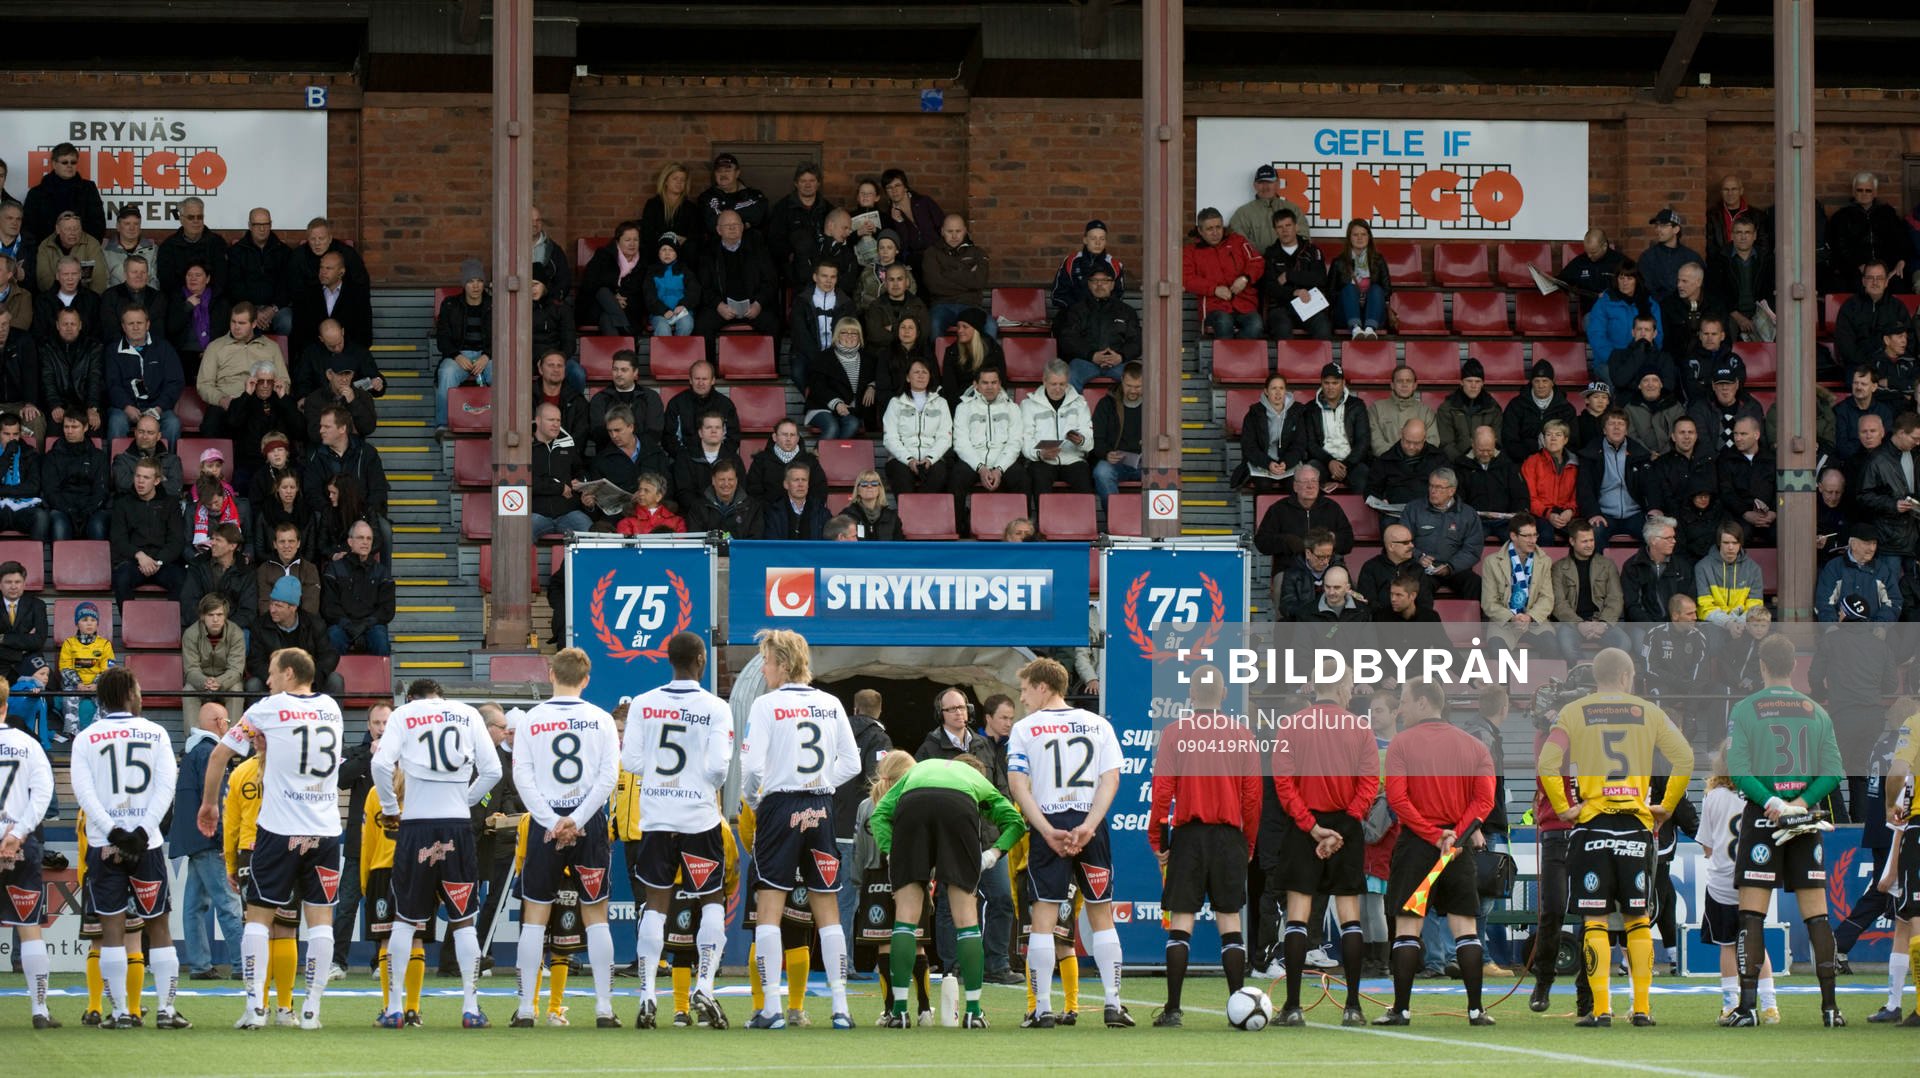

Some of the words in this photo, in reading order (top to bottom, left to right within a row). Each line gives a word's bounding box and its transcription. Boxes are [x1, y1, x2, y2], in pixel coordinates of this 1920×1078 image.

[308, 87, 325, 108] B
[69, 117, 187, 141] BRYNÄS
[1314, 128, 1424, 156] GEFLE
[1444, 131, 1471, 157] IF
[614, 586, 669, 630] 75
[826, 574, 1046, 611] STRYKTIPSET
[1147, 587, 1201, 632] 75
[631, 630, 652, 648] år
[1164, 632, 1185, 650] år
[99, 742, 152, 795] 15
[293, 725, 337, 778] 13
[418, 726, 461, 772] 10
[551, 732, 583, 784] 8
[655, 724, 687, 776] 5
[796, 721, 825, 774] 3
[1044, 736, 1094, 789] 12
[1120, 757, 1149, 774] av
[1602, 730, 1629, 782] 5
[1768, 724, 1808, 776] 31
[1111, 809, 1152, 831] sed
[1584, 839, 1647, 851] COOPER
